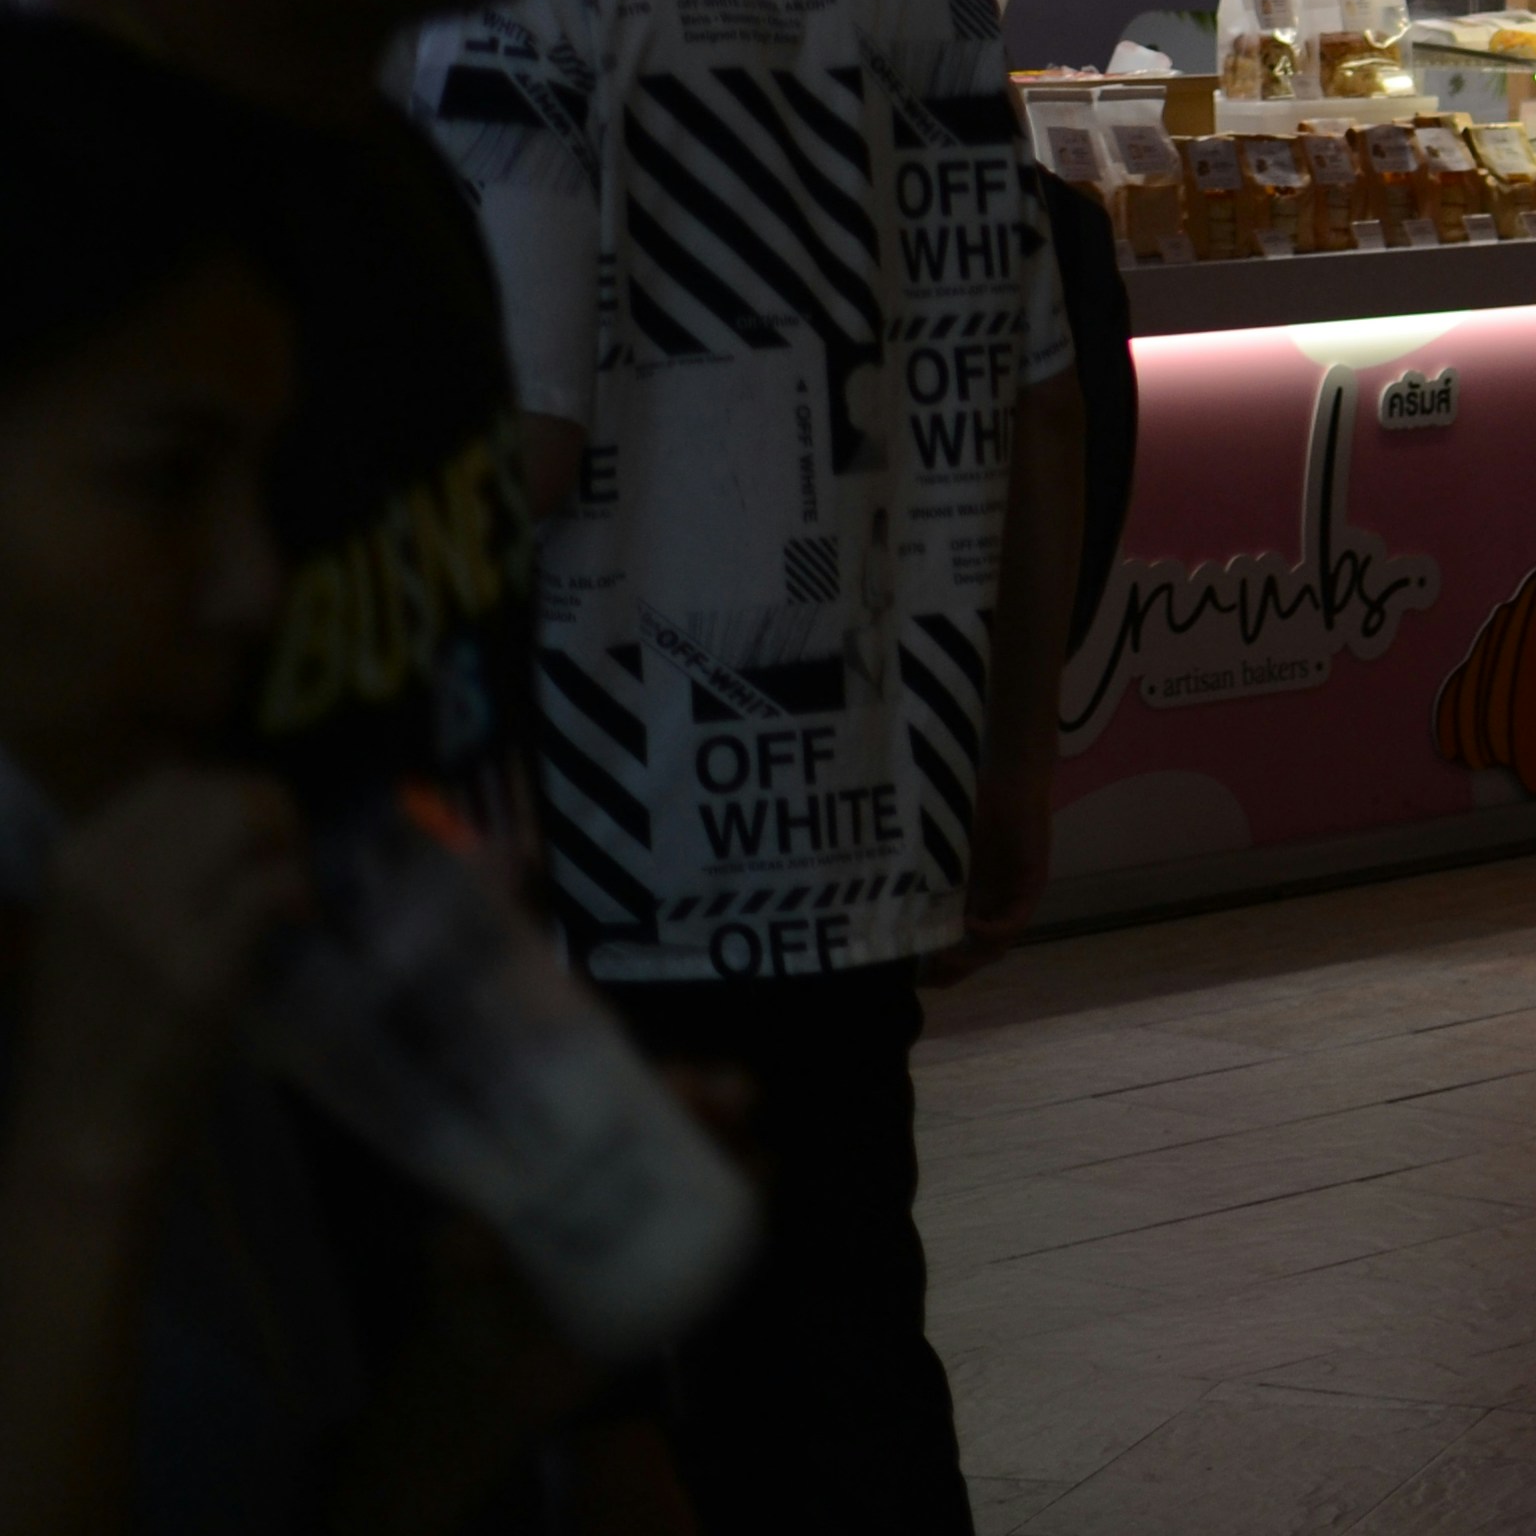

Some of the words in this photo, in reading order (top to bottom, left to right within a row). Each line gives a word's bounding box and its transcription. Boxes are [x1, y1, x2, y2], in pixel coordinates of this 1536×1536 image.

[898, 158, 1010, 221] OFF
[907, 343, 1012, 405] OFF
[1388, 375, 1453, 419] ครัมส์
[799, 453, 820, 524] WHITE
[1163, 669, 1236, 698] artisan
[1241, 657, 1311, 686] bakers
[695, 726, 837, 794] OFF
[699, 784, 905, 860] WHITE
[709, 914, 849, 983] OFF
